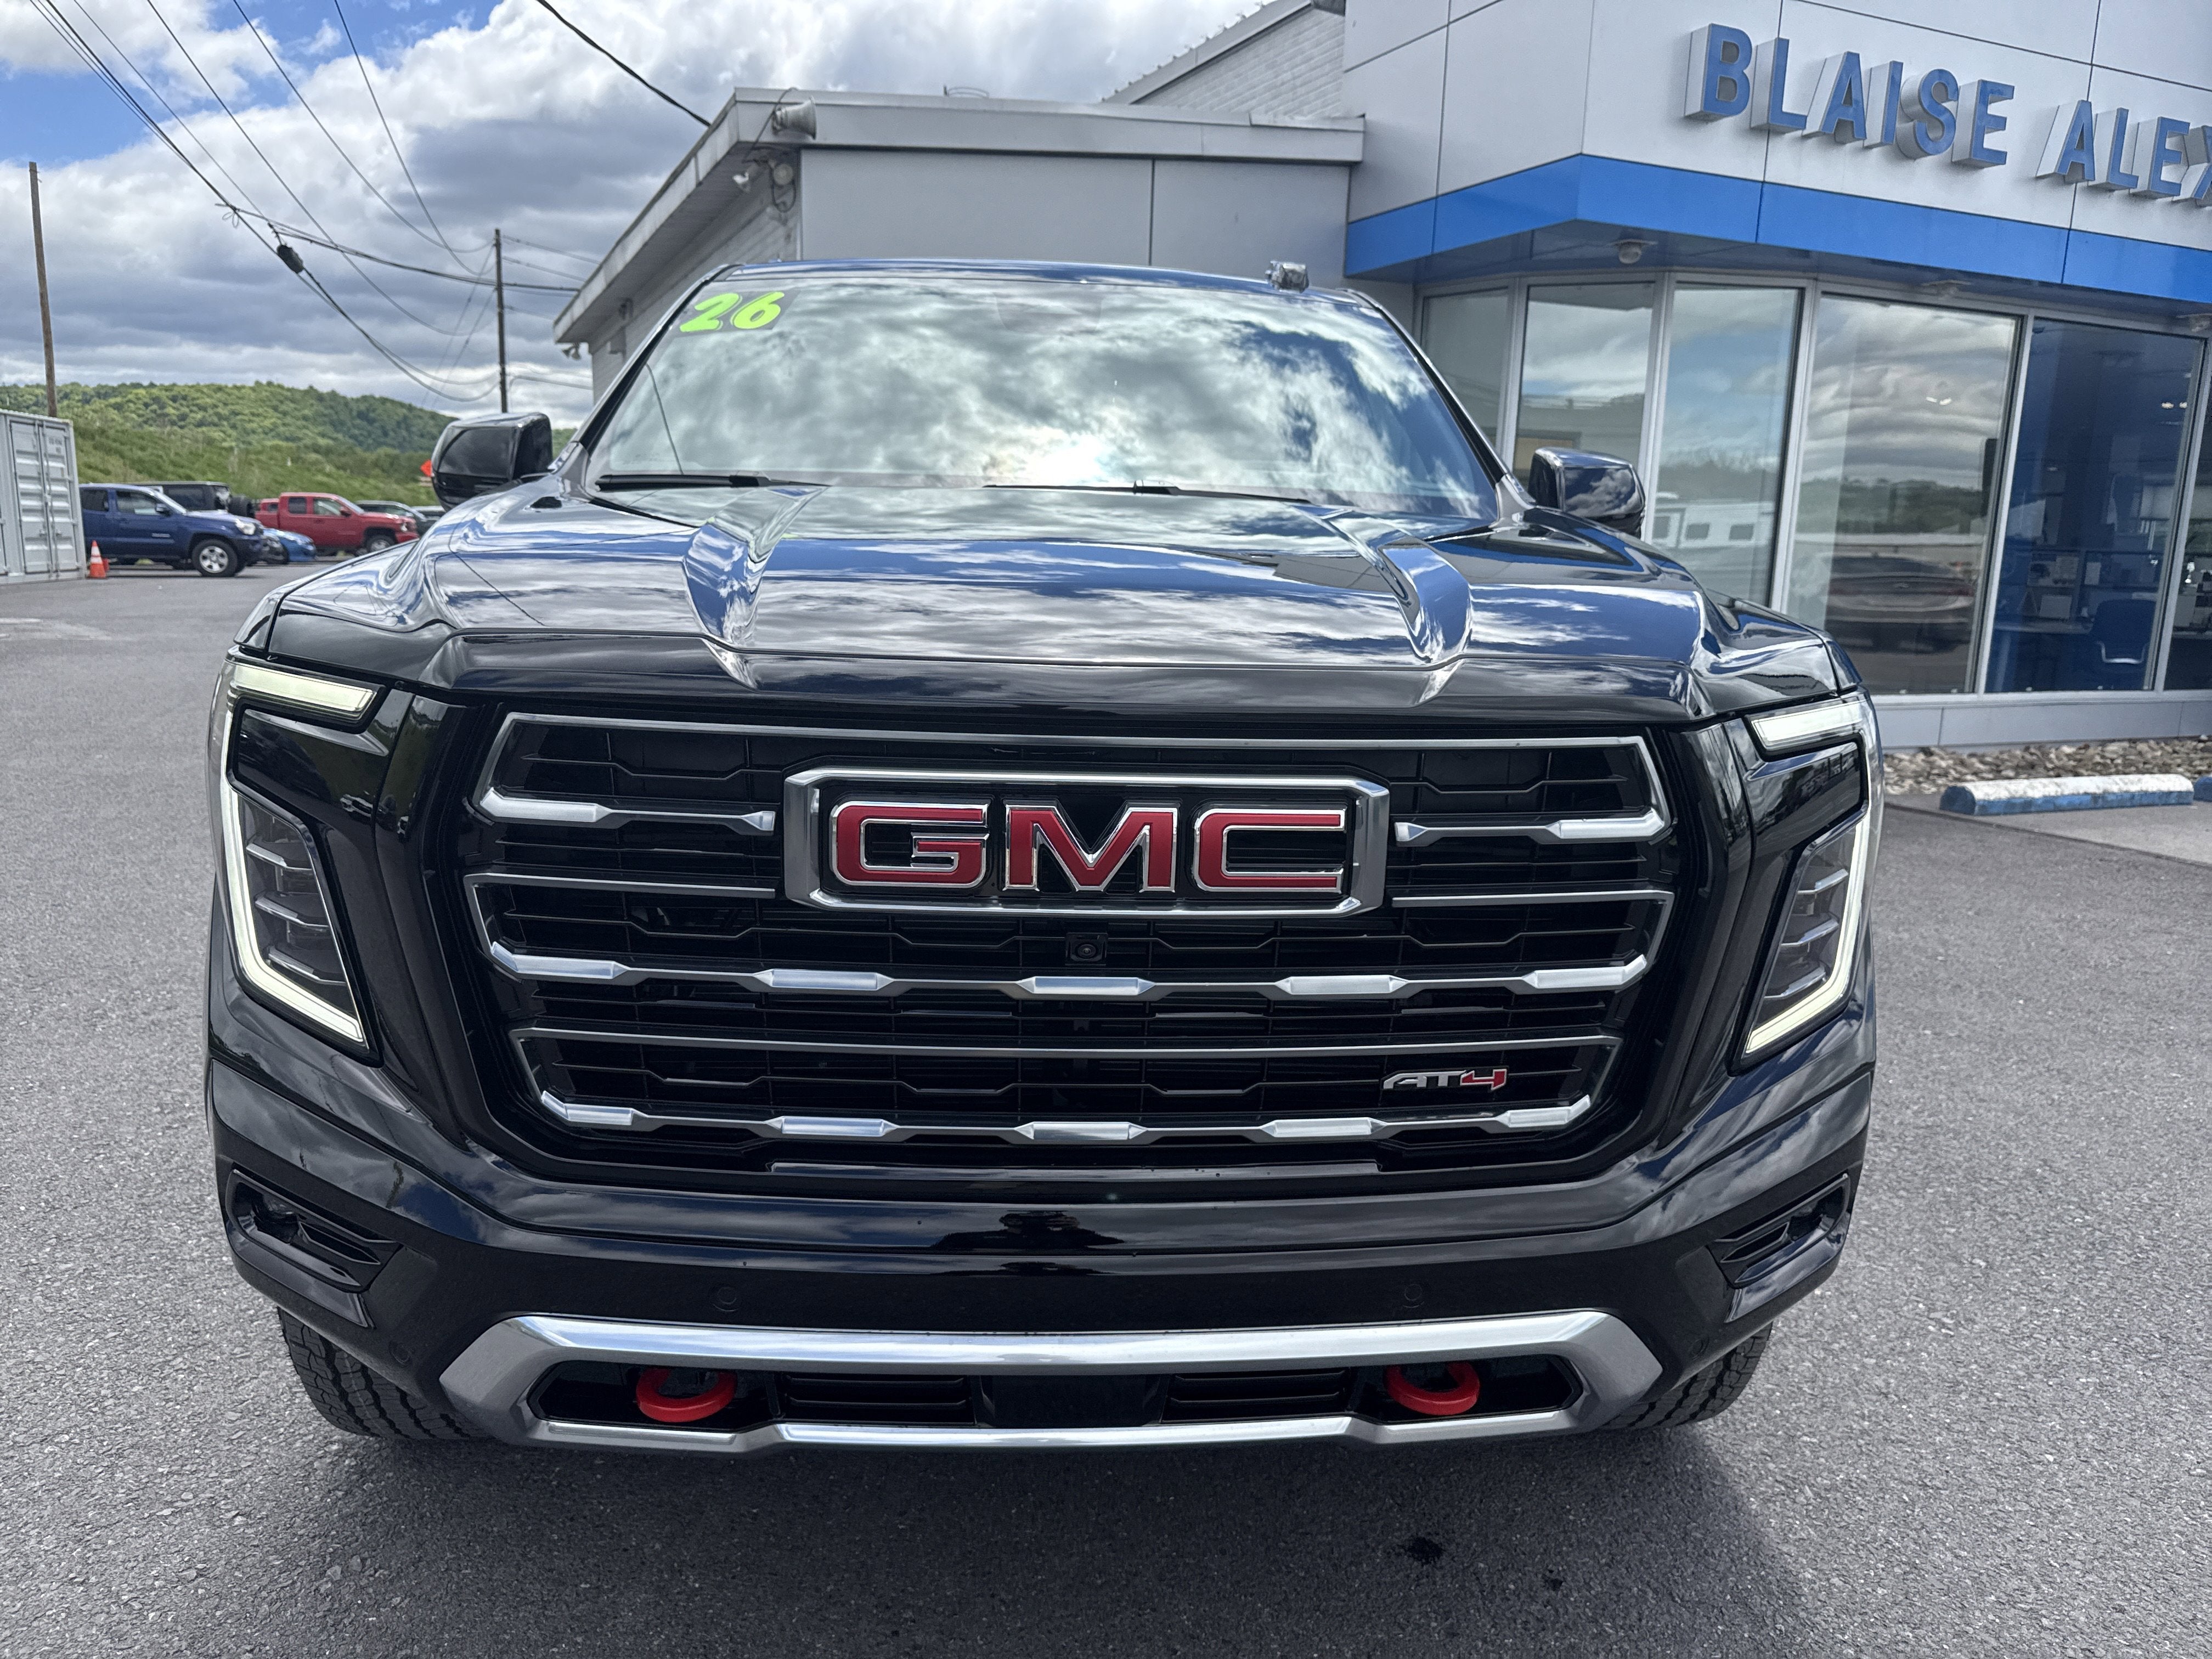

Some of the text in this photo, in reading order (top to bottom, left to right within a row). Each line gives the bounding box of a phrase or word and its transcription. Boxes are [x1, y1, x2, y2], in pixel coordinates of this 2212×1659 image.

[1701, 23, 2015, 167] BLAISE
[679, 291, 785, 332] 26
[830, 800, 1347, 893] GMC
[1383, 1069, 1507, 1091] AT4
